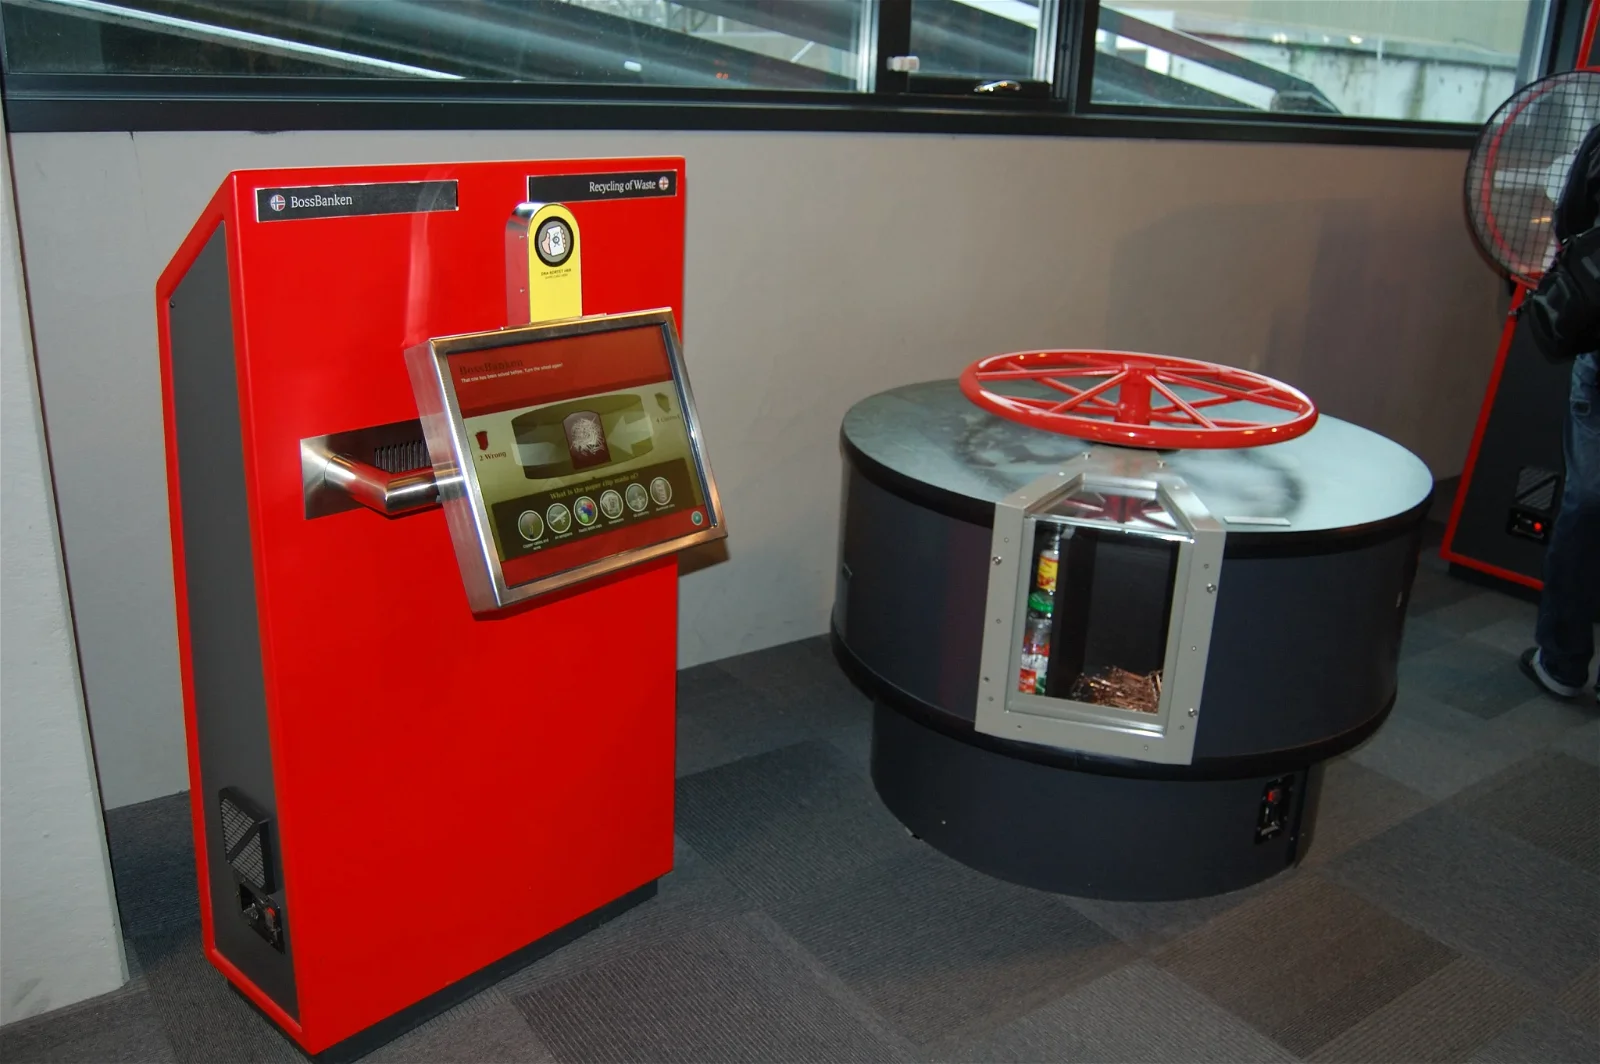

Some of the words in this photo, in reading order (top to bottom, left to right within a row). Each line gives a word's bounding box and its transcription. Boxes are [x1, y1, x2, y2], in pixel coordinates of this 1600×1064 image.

[589, 180, 625, 195] Recycling
[624, 179, 634, 190] of
[634, 179, 656, 191] Waste
[290, 193, 353, 209] BossBanken
[459, 360, 523, 374] BossBanken
[479, 454, 484, 462] 2
[484, 451, 507, 461] Wrong
[549, 490, 567, 500] What
[573, 486, 585, 494] the
[584, 482, 602, 493] paper
